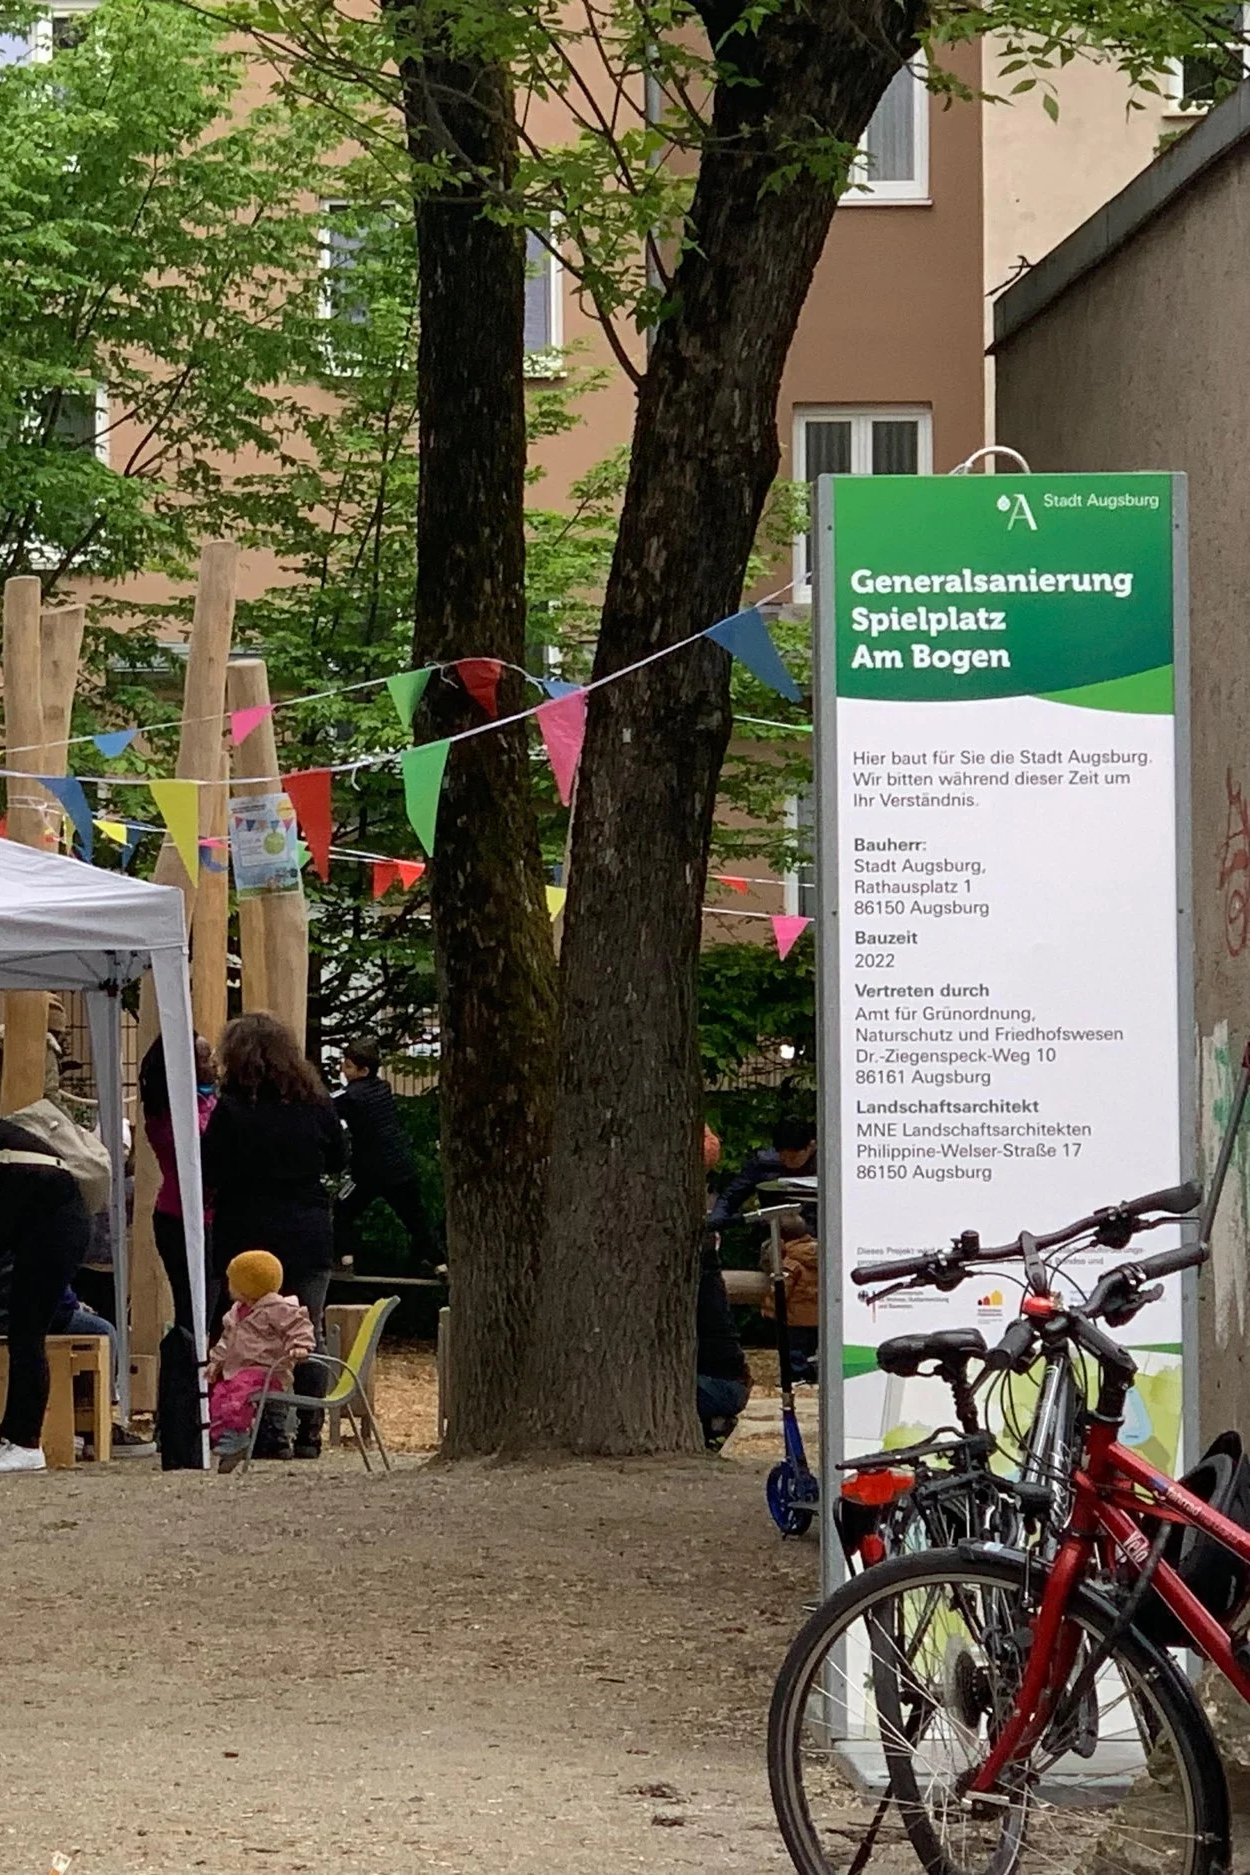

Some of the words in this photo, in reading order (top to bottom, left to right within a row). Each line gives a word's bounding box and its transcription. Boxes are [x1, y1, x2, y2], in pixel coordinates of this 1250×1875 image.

[1044, 493, 1082, 507] Stadt
[1087, 493, 1159, 509] Augsburg
[851, 568, 1133, 597] Generalsanierung
[852, 606, 1006, 637] Spielplatz
[851, 644, 903, 668] Am
[911, 644, 1010, 674] Bogen
[854, 752, 885, 765] Hier
[892, 751, 926, 765] baut
[933, 751, 954, 764] für
[961, 751, 985, 764] Sie
[991, 751, 1014, 764] die
[1020, 750, 1062, 764] Stadt
[1068, 750, 1153, 767] Augsburg.
[853, 773, 881, 786] Wir
[888, 772, 932, 786] bitten
[939, 772, 1009, 785] während
[1015, 772, 1063, 785] dieser
[1069, 771, 1099, 784] Zeit
[1105, 774, 1130, 784] um
[854, 794, 874, 806] Ihr
[880, 793, 978, 807] Verständnis.
[855, 838, 926, 851] Bauherr:
[854, 859, 896, 872] Stadt
[902, 858, 985, 876] Augsburg,
[855, 880, 957, 896] Rathausplatz
[965, 879, 970, 892] 1
[855, 900, 904, 915] 86150
[910, 901, 989, 917] Augsburg
[855, 931, 917, 944] Bauzeit
[855, 954, 894, 968] 2022
[855, 984, 934, 997] Vertreten
[940, 984, 989, 997] durch
[855, 1007, 889, 1020] Amt
[895, 1007, 917, 1020] für
[923, 1007, 1035, 1023] Grünordnung,
[856, 1028, 952, 1042] Naturschutz
[959, 1028, 989, 1041] und
[996, 1027, 1123, 1041] Friedhofswesen
[857, 1048, 1029, 1066] Dr.-Ziegenspeck-Weg
[1038, 1048, 1056, 1062] 10
[856, 1070, 903, 1084] 86161
[912, 1070, 990, 1087] Augsburg
[857, 1099, 1039, 1114] Landschaftsarchitekt
[857, 1123, 896, 1137] MNE
[903, 1122, 1091, 1136] Landschaftsarchitekten
[857, 1143, 1056, 1161] Philippine-Welser-Straße
[1063, 1143, 1081, 1157] 17
[857, 1165, 907, 1179] 86150
[913, 1165, 991, 1182] Augsburg
[1123, 1528, 1150, 1563] Velo
